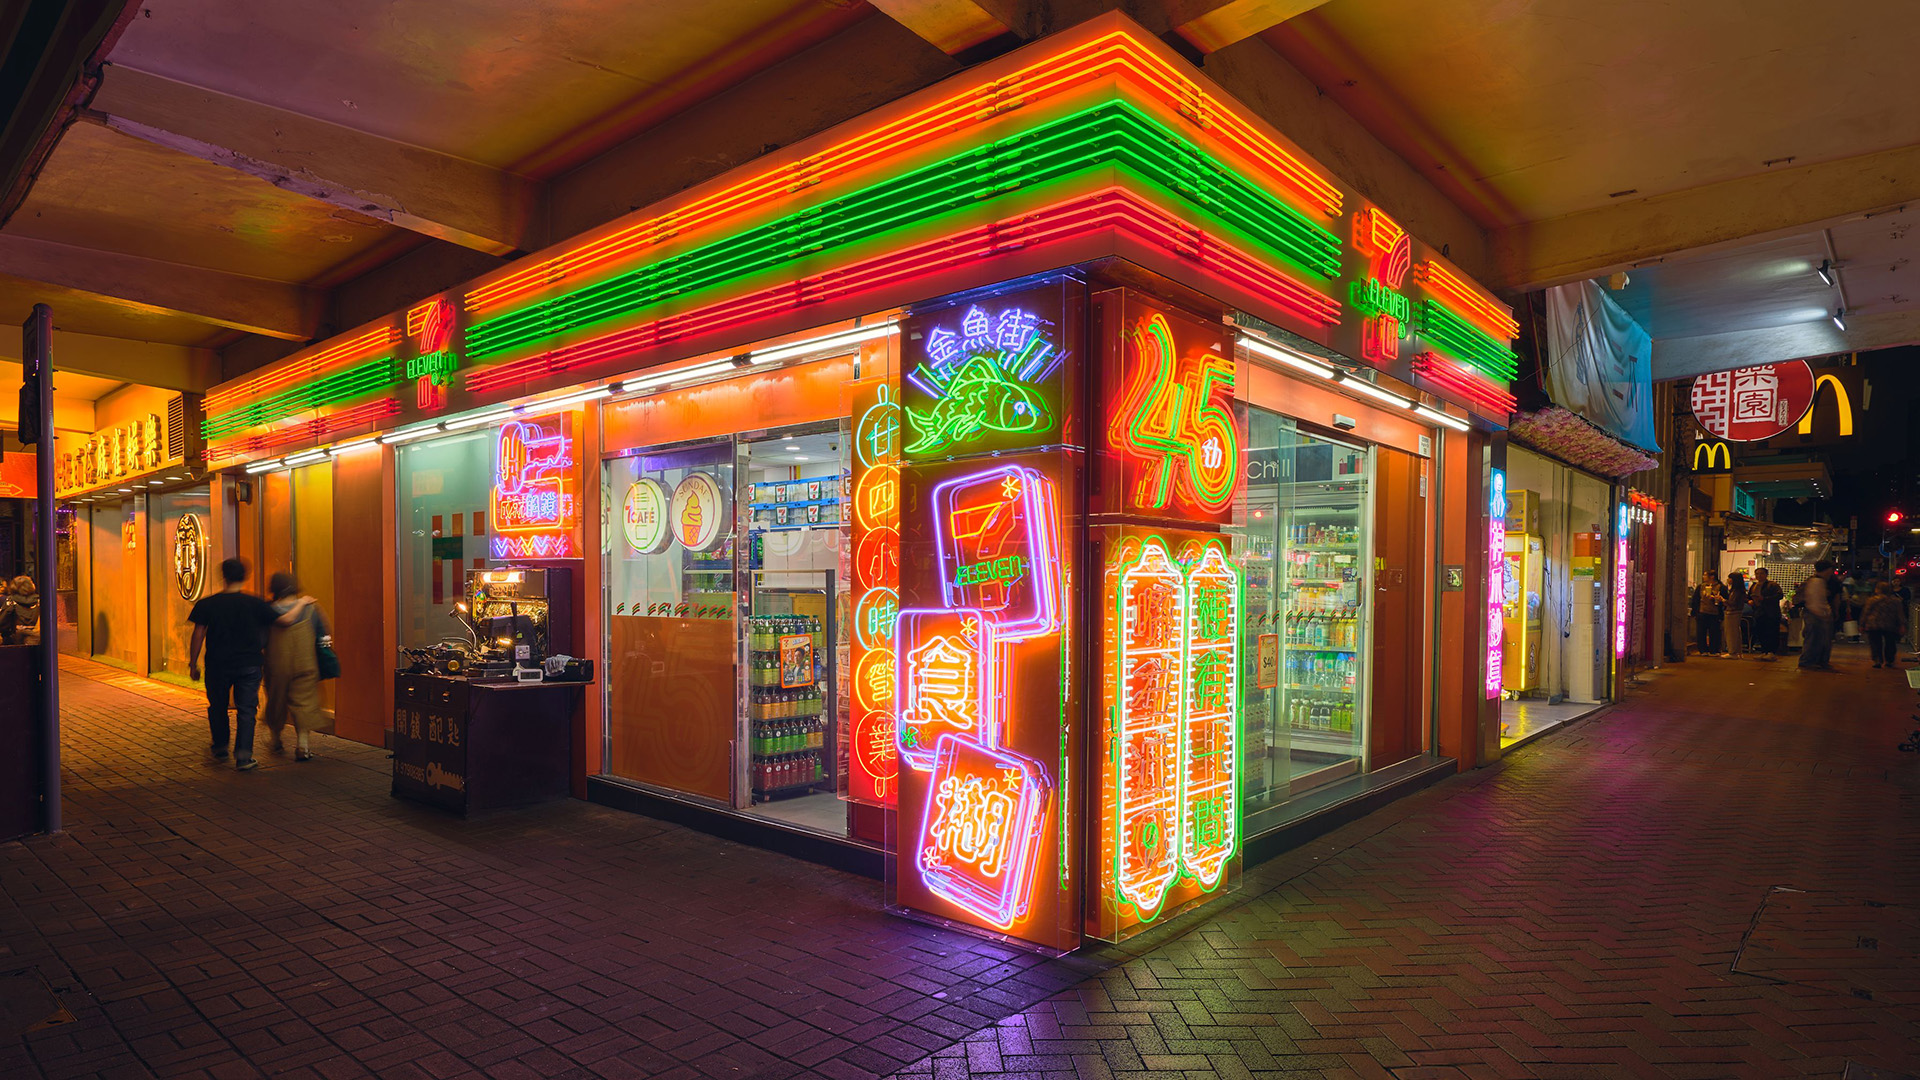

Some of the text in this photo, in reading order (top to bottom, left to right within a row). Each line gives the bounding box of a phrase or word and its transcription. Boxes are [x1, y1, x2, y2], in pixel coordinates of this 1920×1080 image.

[926, 307, 1037, 368] 金魚街
[1122, 313, 1240, 514] 45
[1247, 458, 1290, 480] Chill
[395, 708, 460, 747] 開鎖配匙
[902, 635, 973, 731] 食
[1192, 586, 1230, 854] 梗有一間
[930, 776, 1014, 878] 潮
